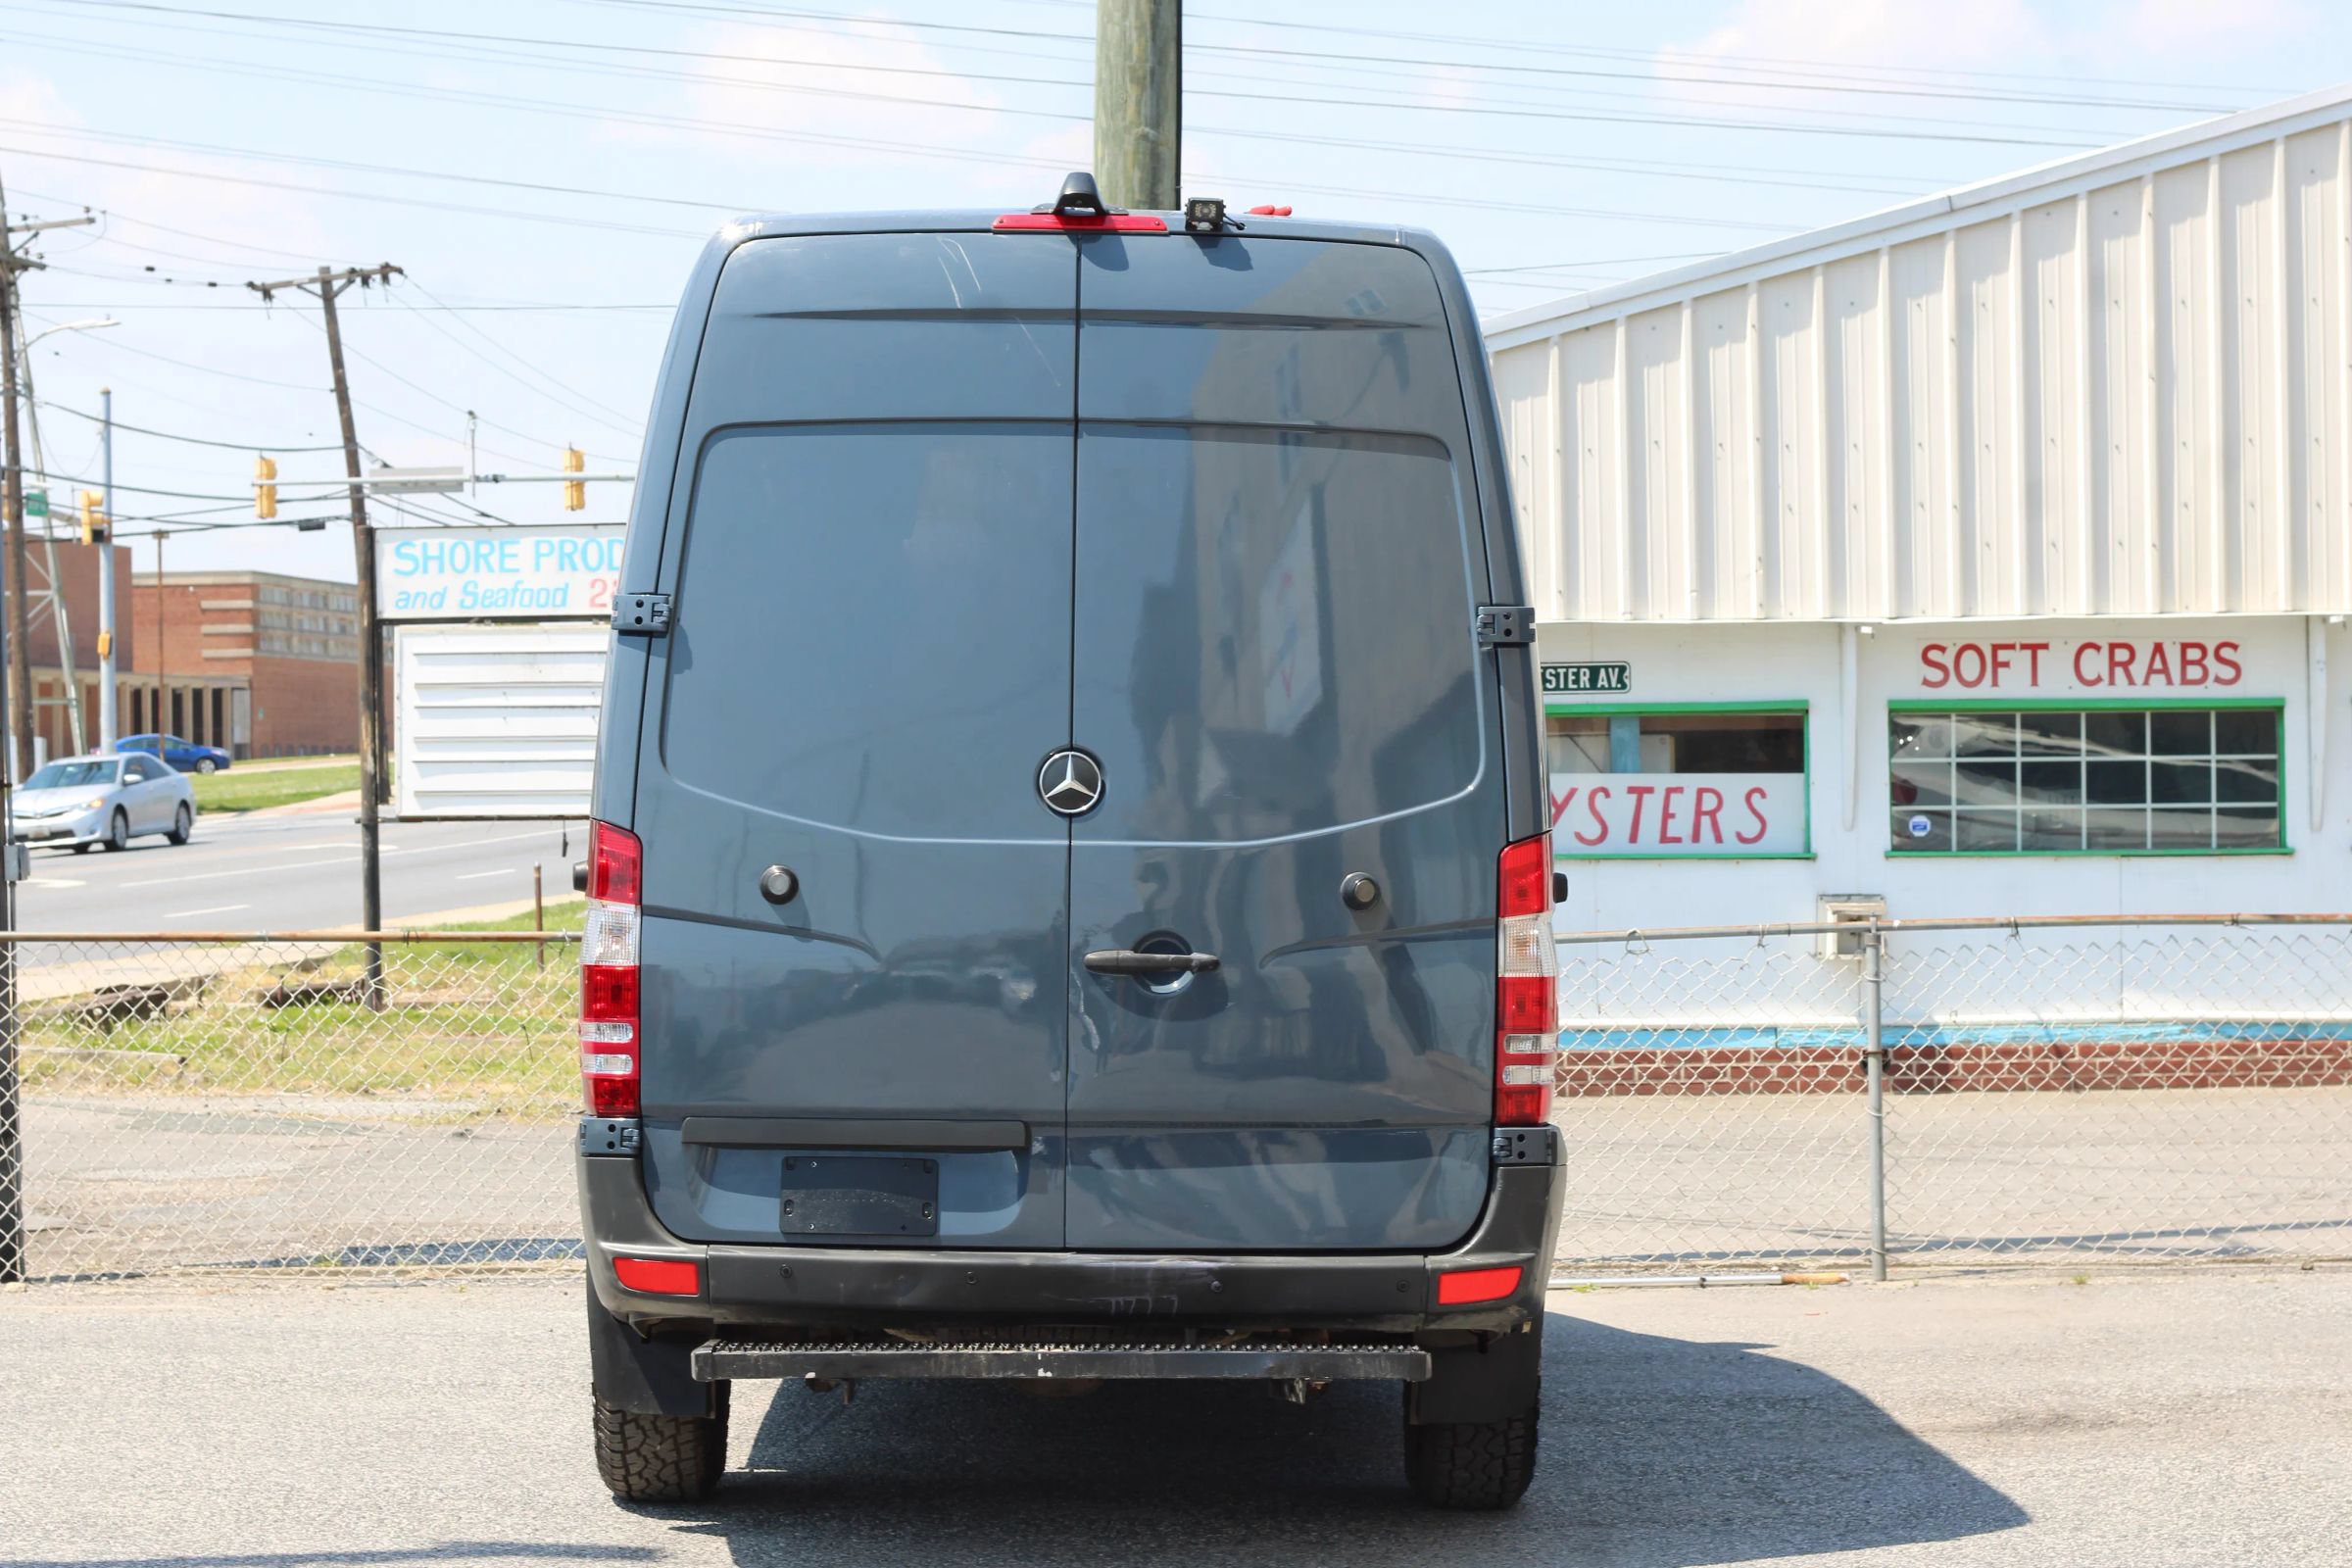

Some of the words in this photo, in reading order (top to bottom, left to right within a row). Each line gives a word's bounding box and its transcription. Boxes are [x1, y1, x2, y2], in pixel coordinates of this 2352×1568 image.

[393, 538, 520, 576] SHORE
[395, 586, 448, 610] and
[459, 579, 569, 610] Seafood
[589, 578, 618, 609] 2
[1541, 667, 1591, 689] STER
[1596, 667, 1622, 688] AV.
[1921, 642, 2050, 689] SOFT
[2073, 641, 2243, 687] CRABS
[1550, 786, 1768, 846] YSTERS
